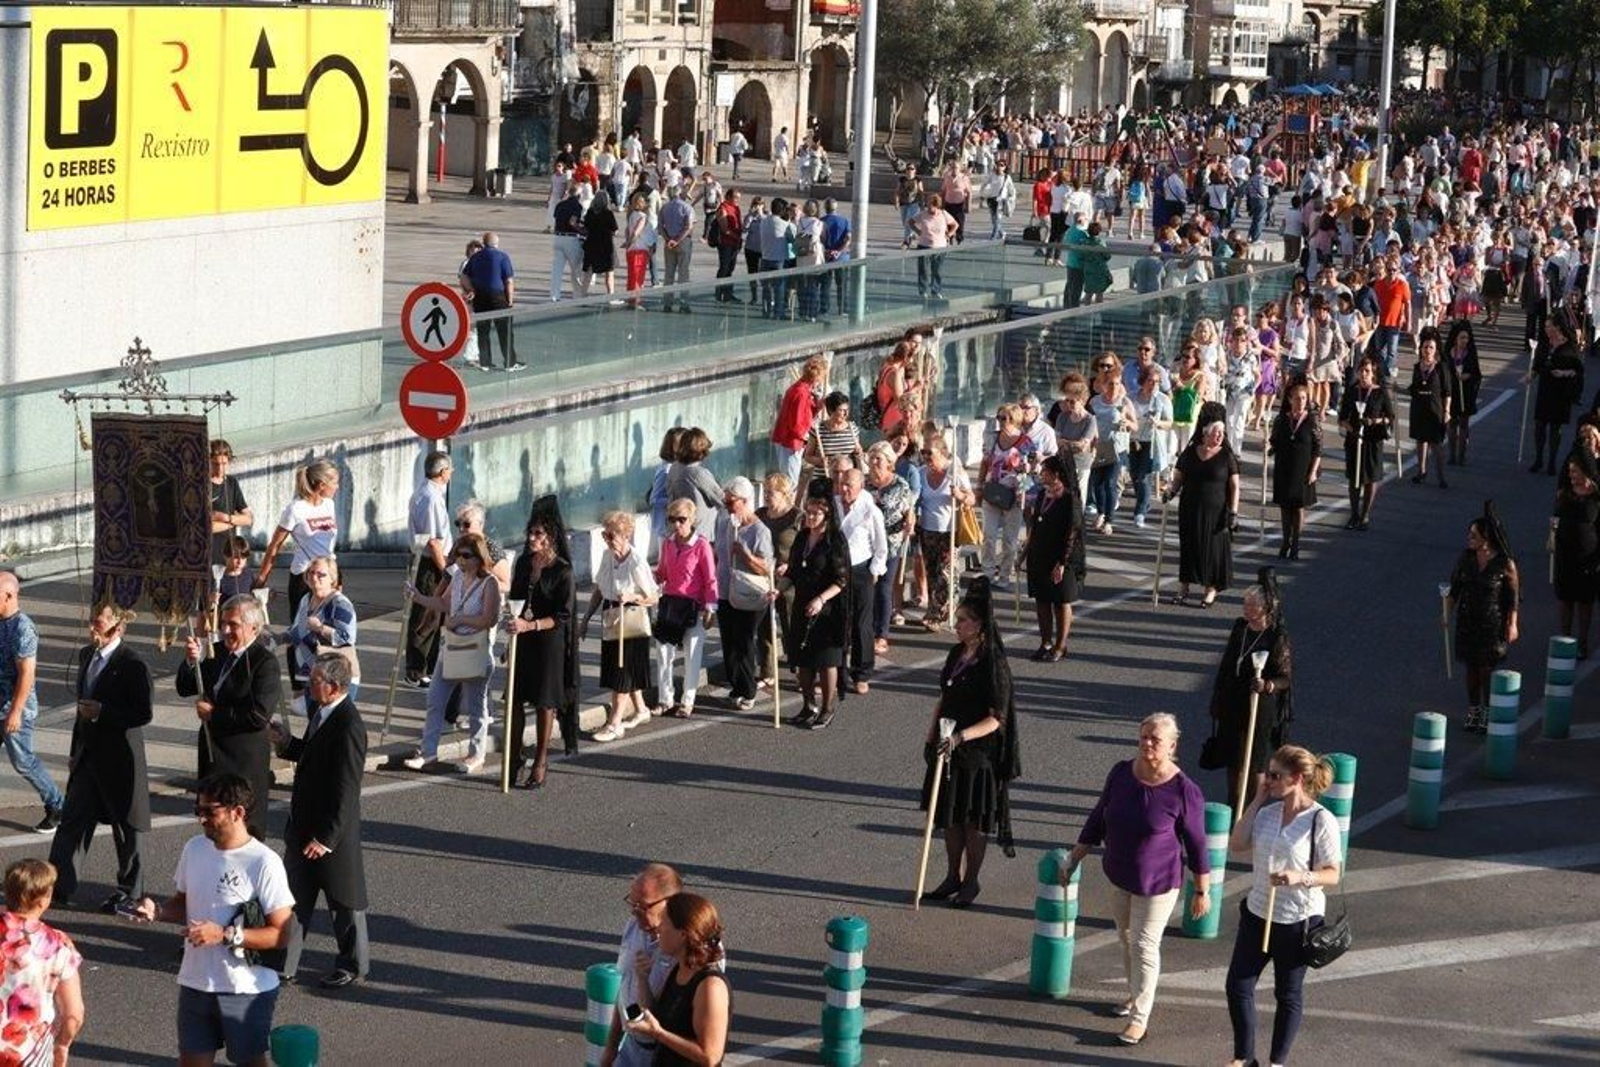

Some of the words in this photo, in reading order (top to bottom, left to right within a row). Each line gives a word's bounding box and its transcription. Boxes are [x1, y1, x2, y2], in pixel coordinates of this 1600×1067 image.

[60, 43, 109, 135] P
[161, 40, 192, 112] R
[140, 132, 210, 159] Rexistro
[43, 162, 54, 179] O
[59, 158, 116, 178] BERBES
[42, 188, 60, 209] 24
[64, 184, 116, 207] HORAS
